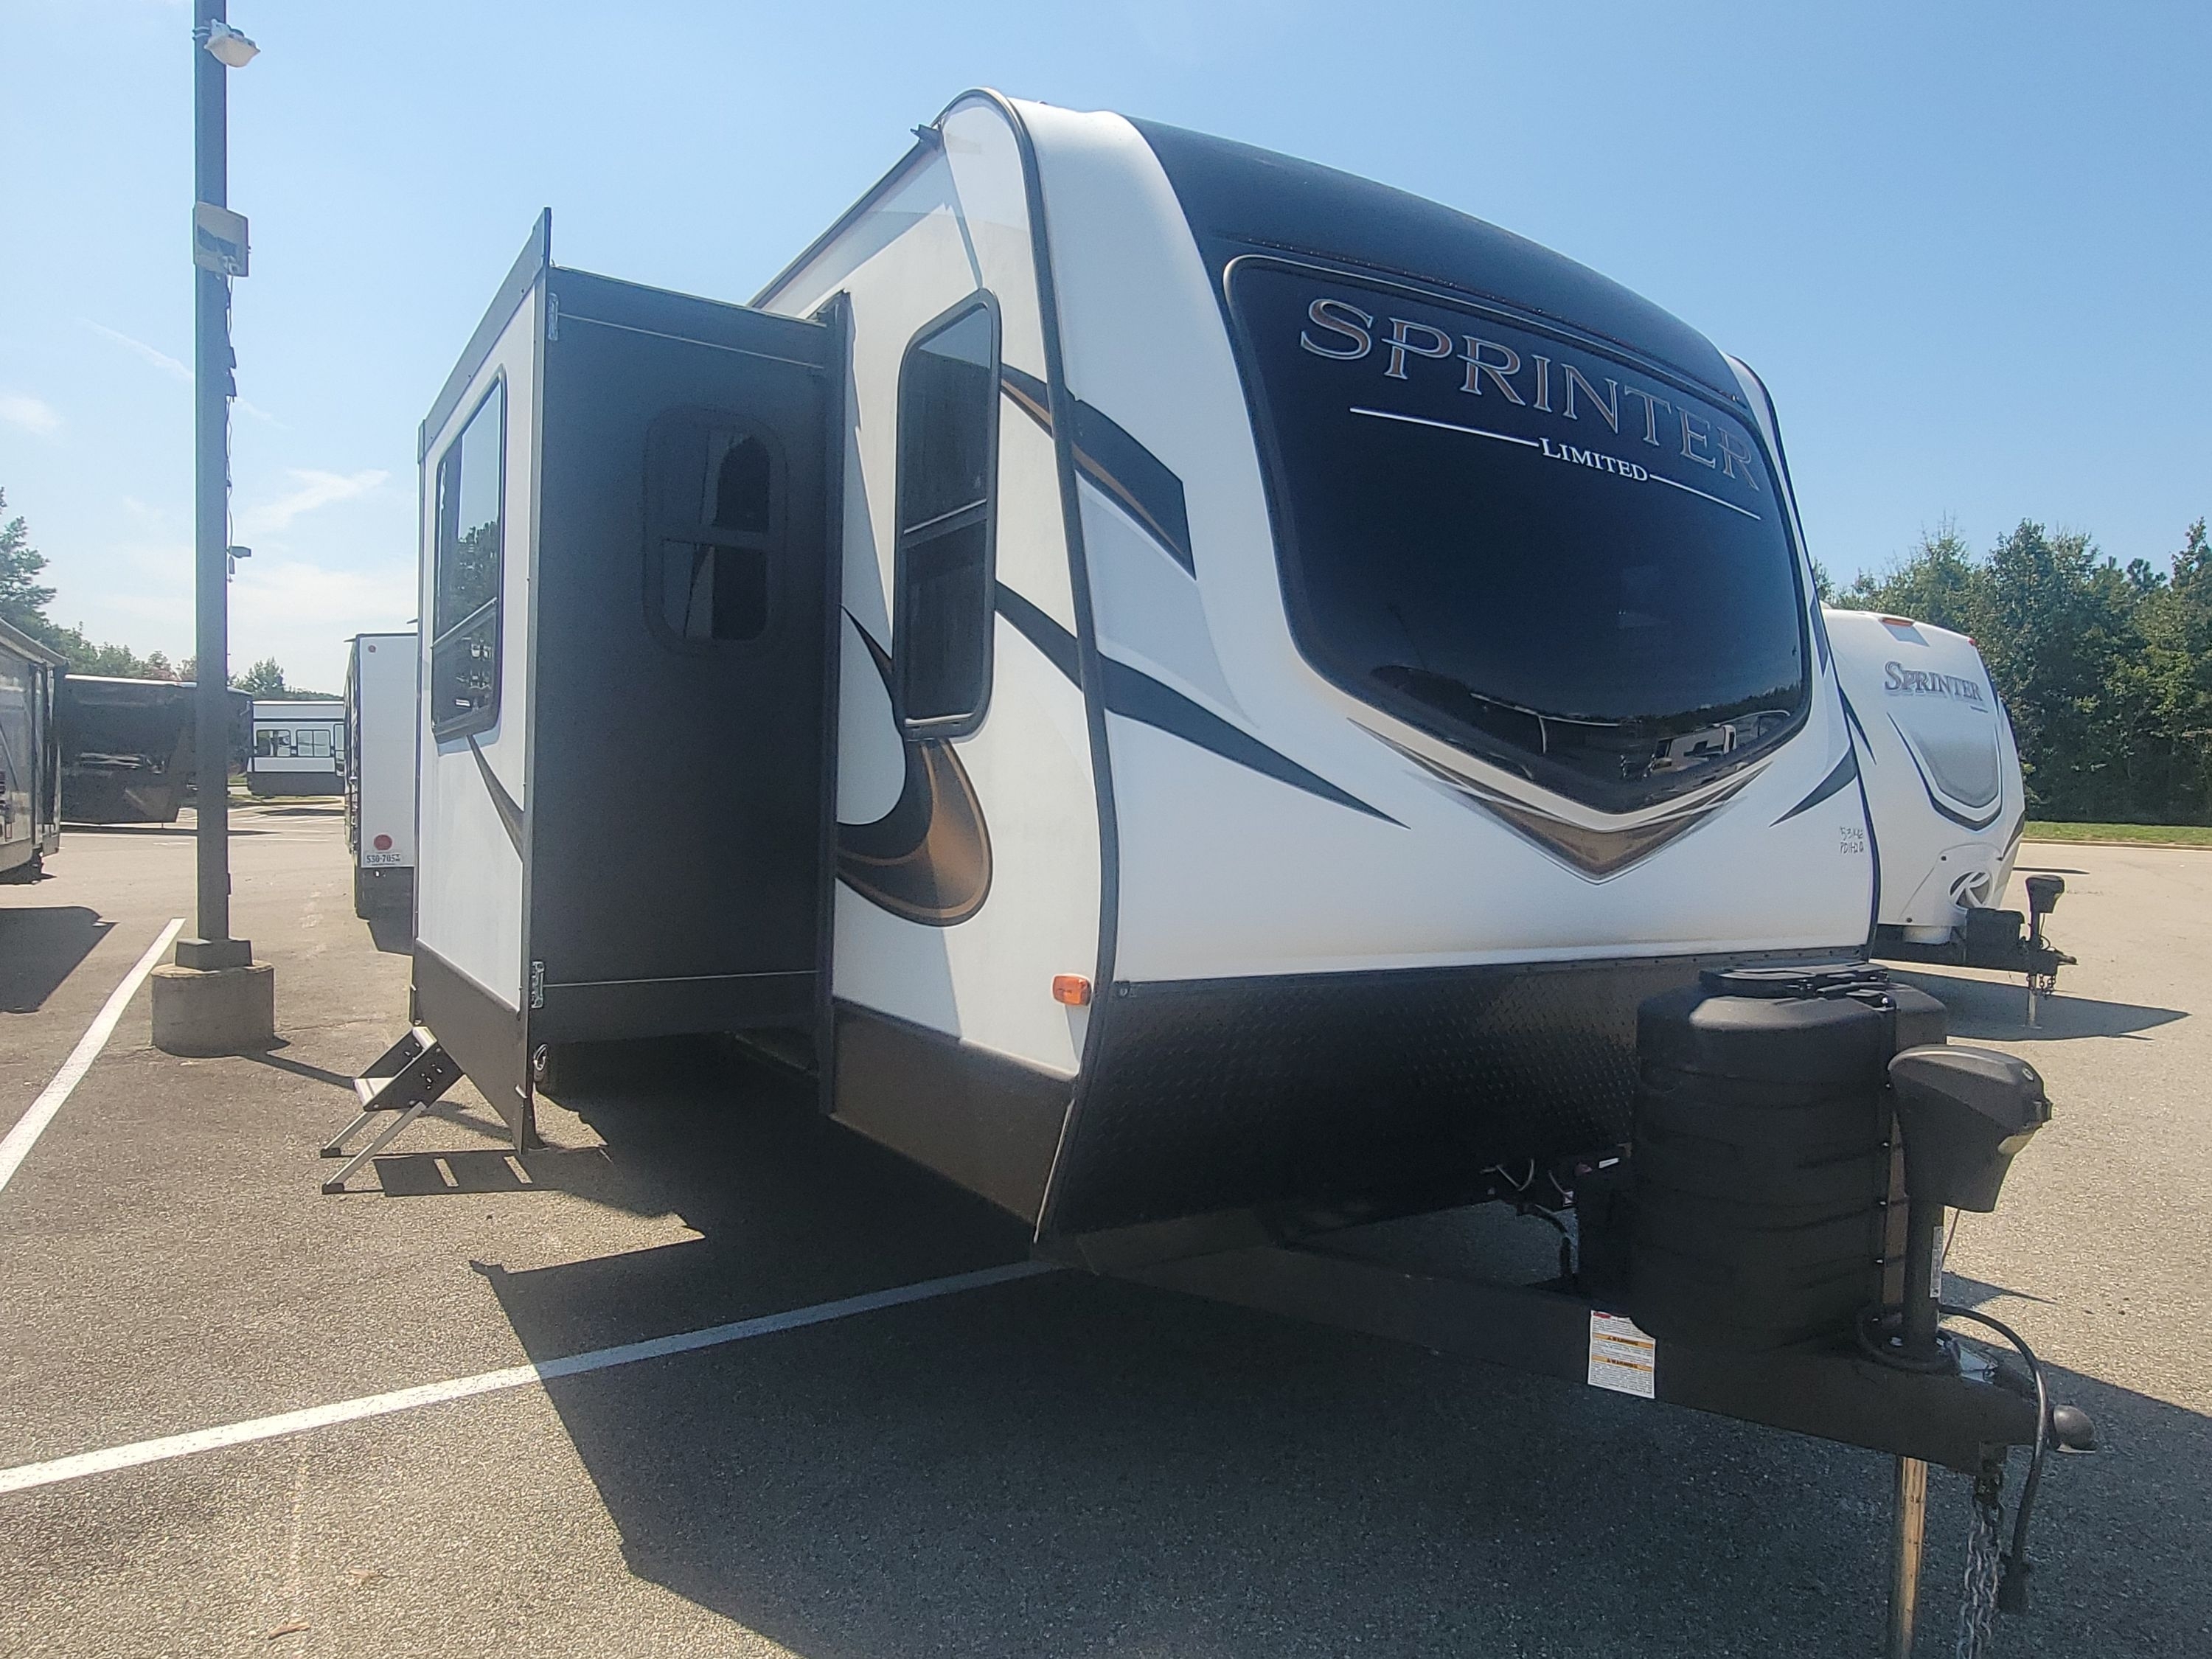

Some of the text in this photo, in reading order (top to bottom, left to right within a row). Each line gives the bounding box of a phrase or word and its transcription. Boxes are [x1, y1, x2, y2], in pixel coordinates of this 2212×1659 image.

[1300, 298, 1761, 492] SPRINTER
[1539, 437, 1649, 481] LIMITED
[1885, 661, 1983, 701] SPRINTER
